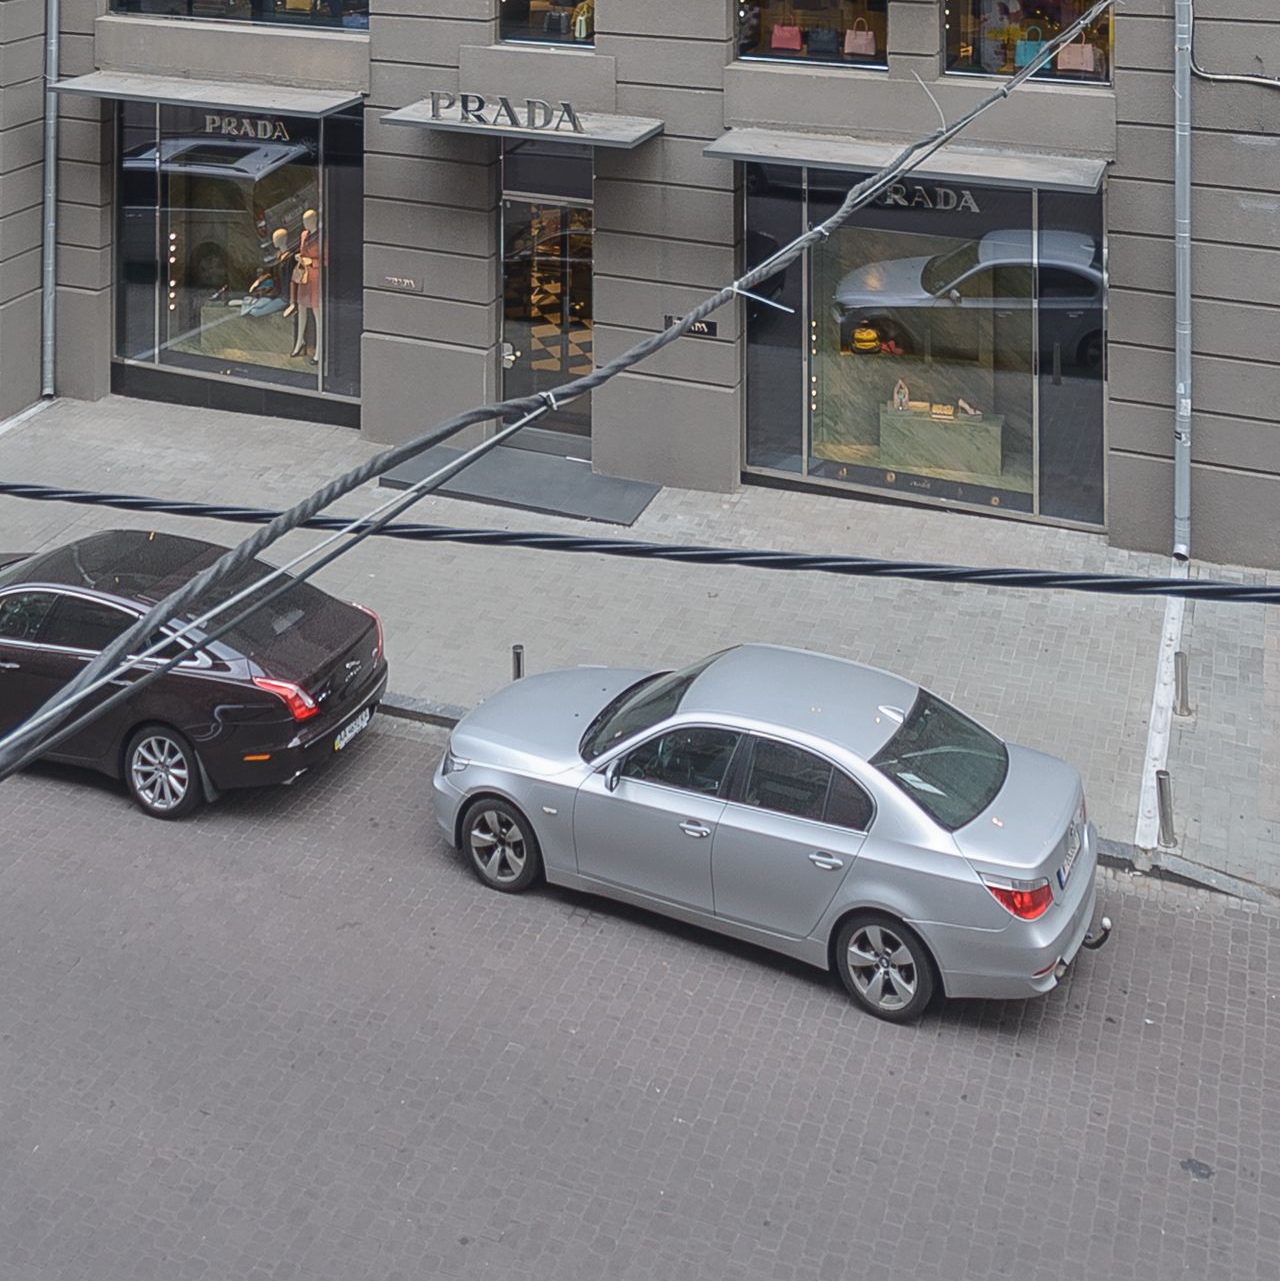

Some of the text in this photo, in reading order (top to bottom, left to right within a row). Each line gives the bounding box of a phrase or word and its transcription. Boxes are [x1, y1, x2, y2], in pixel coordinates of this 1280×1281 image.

[429, 89, 586, 135] PRADA
[204, 115, 290, 141] PRADA
[883, 183, 980, 213] RADA
